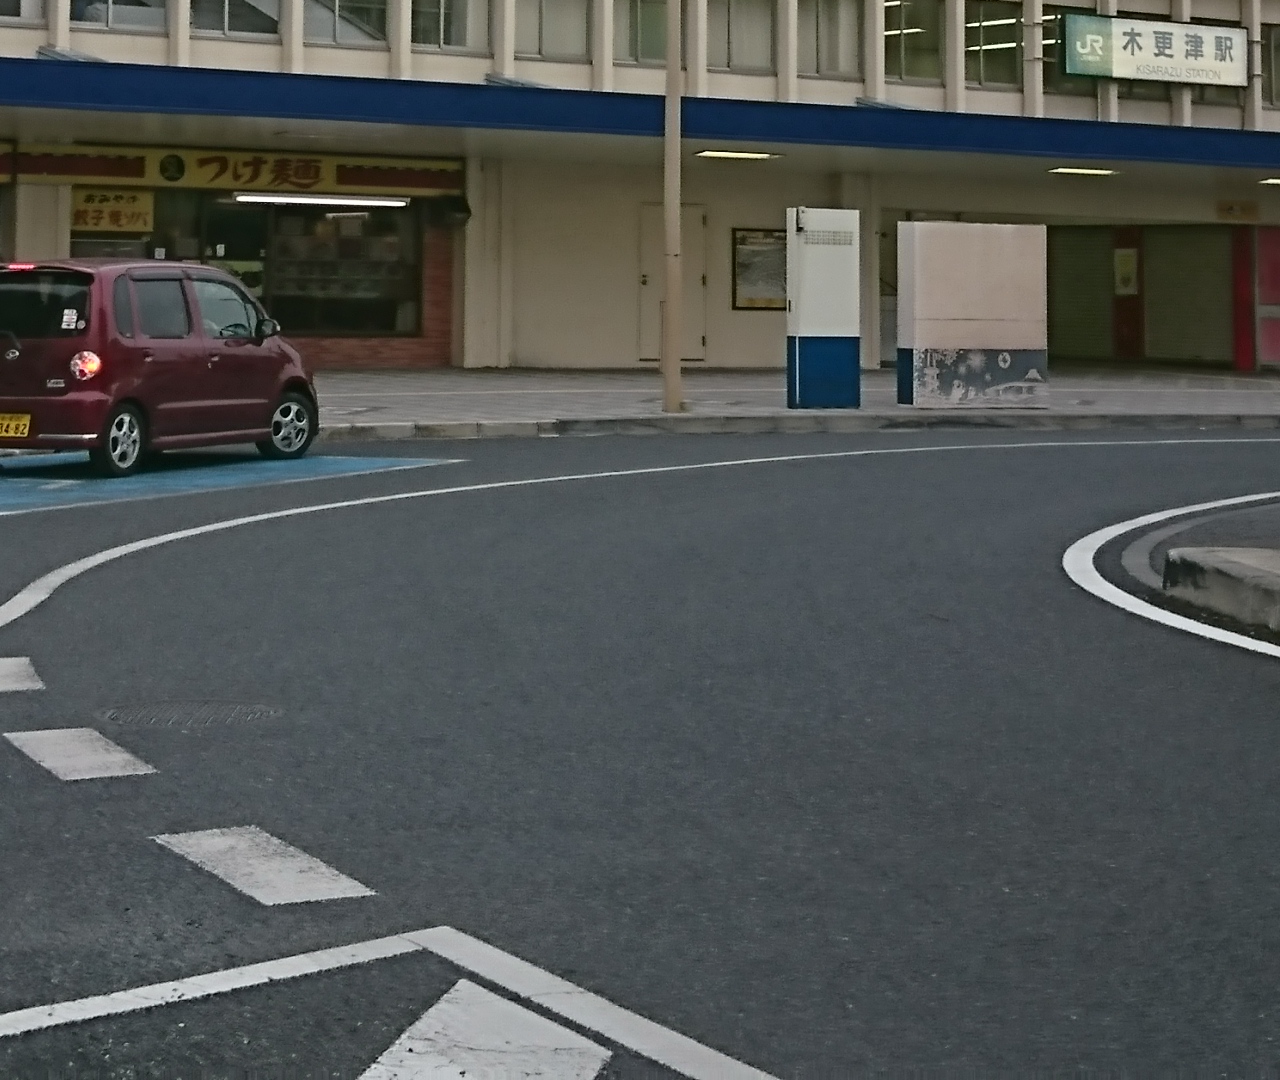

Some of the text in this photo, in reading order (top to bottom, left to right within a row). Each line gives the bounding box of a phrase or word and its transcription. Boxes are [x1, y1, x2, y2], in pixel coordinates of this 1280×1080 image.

[1076, 34, 1103, 55] JR
[1122, 27, 1235, 63] 木更津駅
[1136, 64, 1221, 80] KISARAZU STATION
[196, 155, 324, 189] つけ麺
